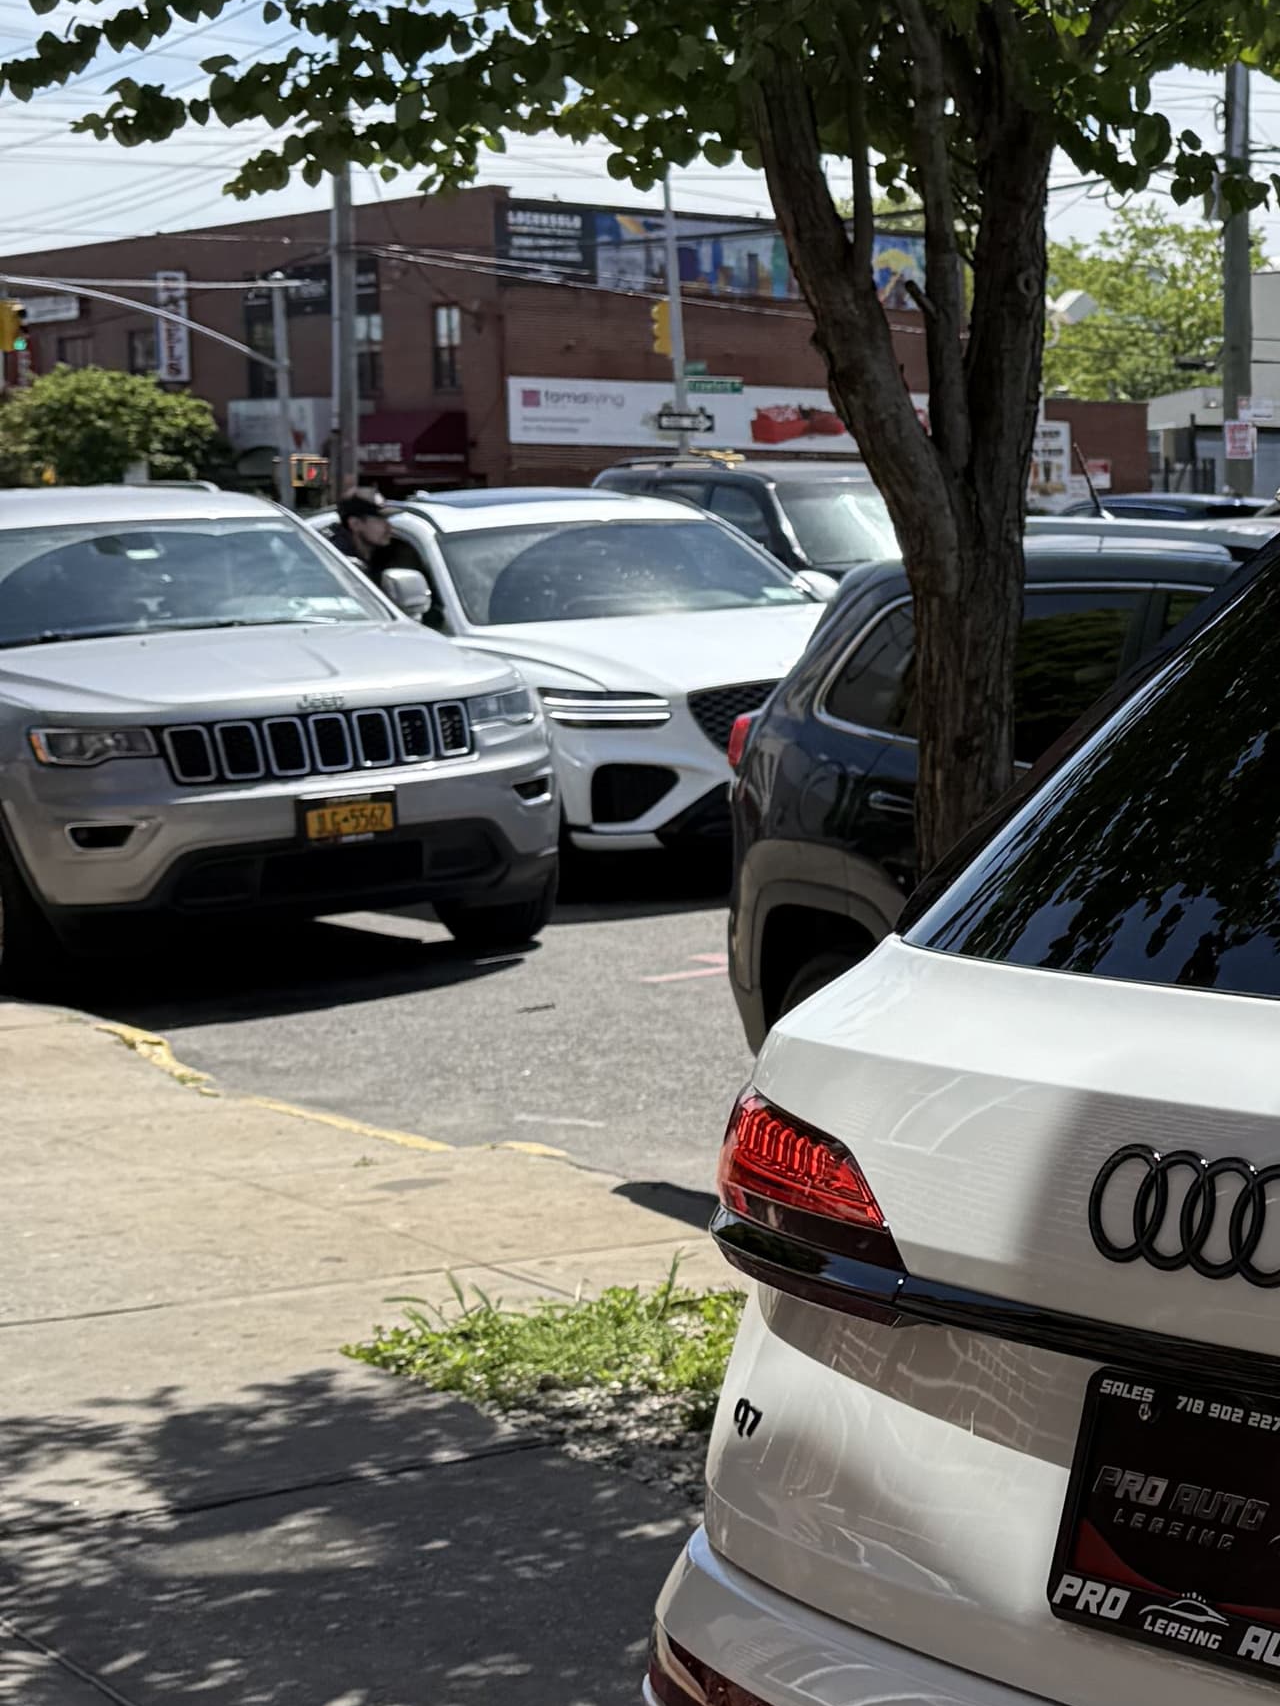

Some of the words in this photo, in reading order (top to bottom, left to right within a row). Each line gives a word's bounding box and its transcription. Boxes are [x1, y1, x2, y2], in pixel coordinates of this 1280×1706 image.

[1099, 1379, 1155, 1403] SALES
[1175, 1395, 1204, 1415] 718
[1207, 1402, 1244, 1424] 902
[1092, 1464, 1169, 1507] PRO
[1168, 1482, 1270, 1532] AUTO
[1112, 1508, 1236, 1552] LEASING
[1051, 1573, 1131, 1621] PRO
[1143, 1615, 1223, 1651] LEASING
